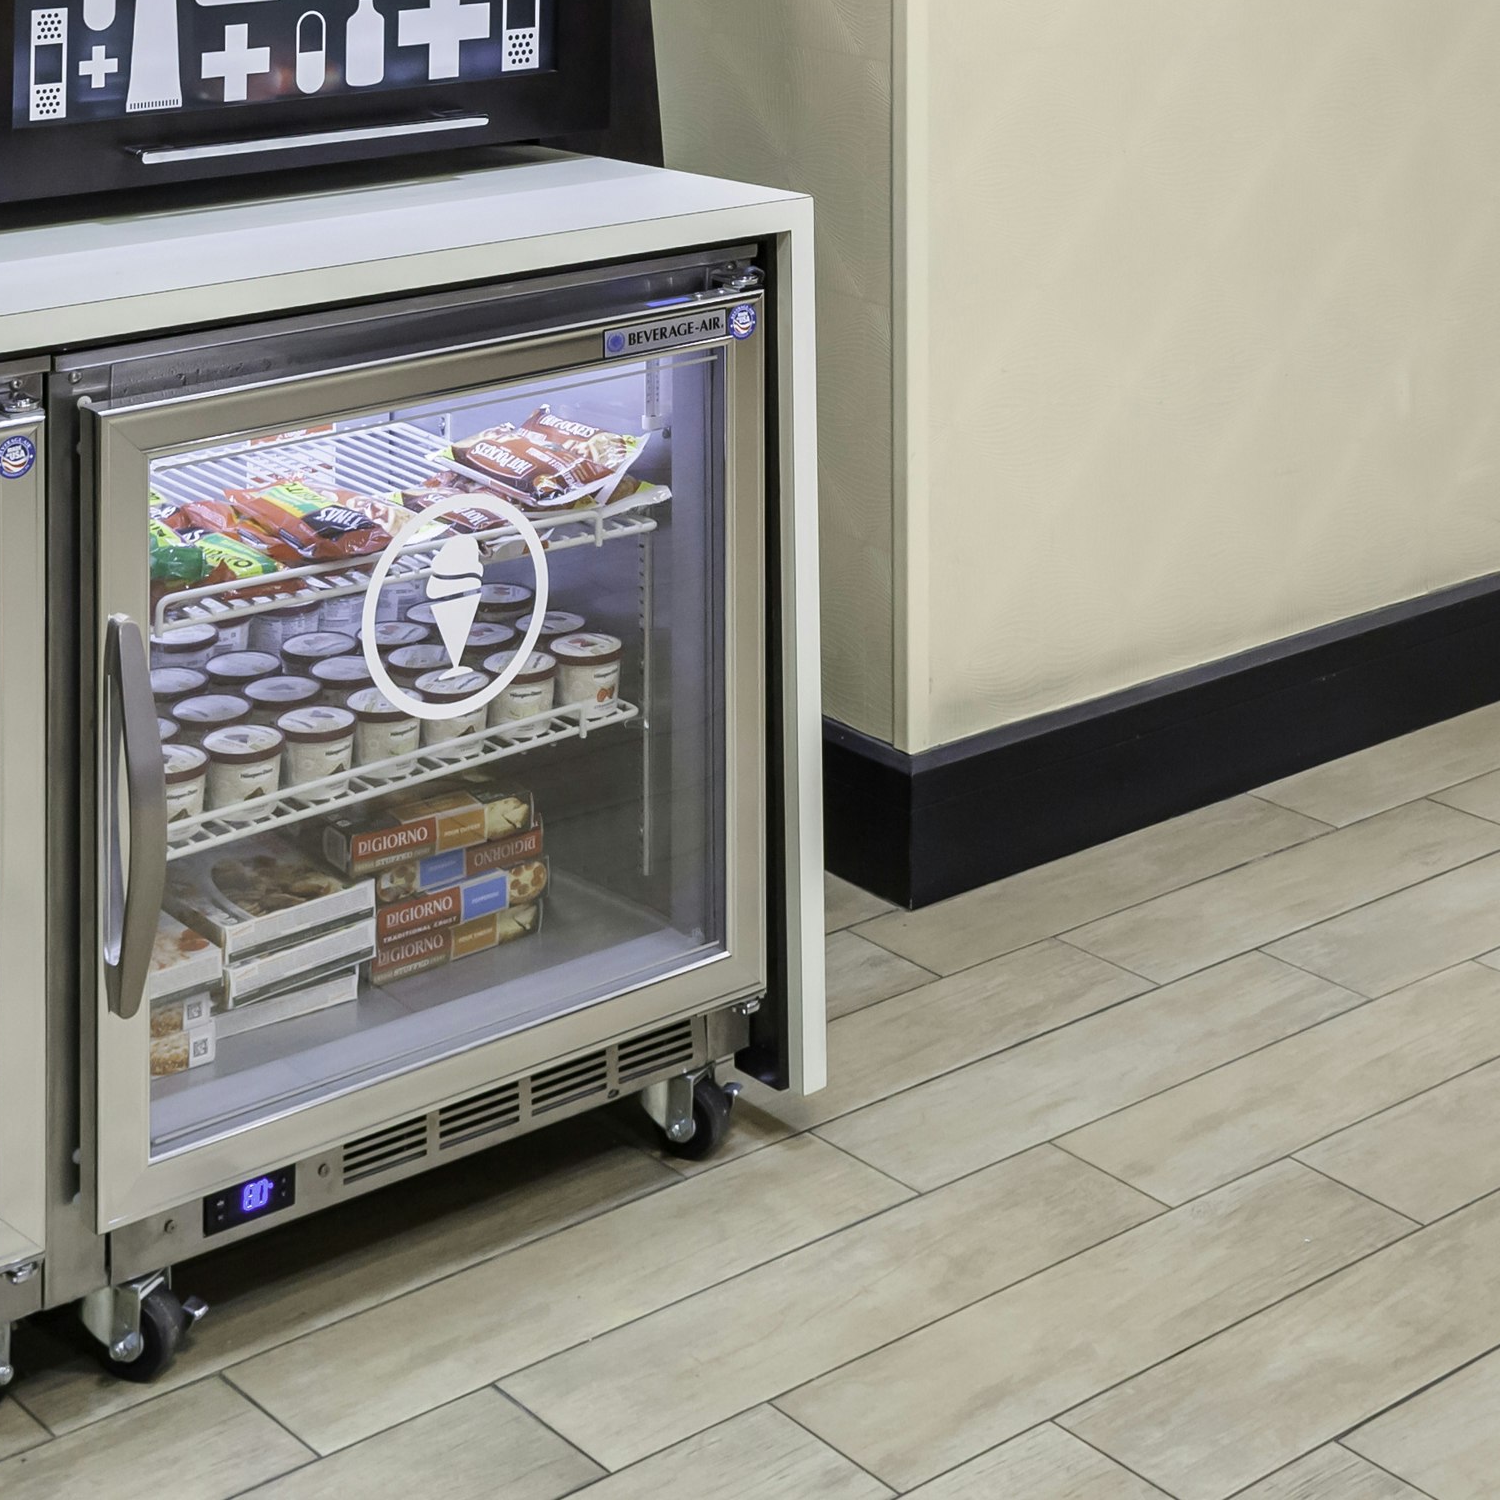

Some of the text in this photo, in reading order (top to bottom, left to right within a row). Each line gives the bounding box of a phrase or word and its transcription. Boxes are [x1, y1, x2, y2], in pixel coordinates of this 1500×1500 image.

[628, 317, 721, 346] BEVERAGE-AIR
[358, 827, 429, 857] DIGIORNO
[387, 896, 453, 928] DIGIORNO
